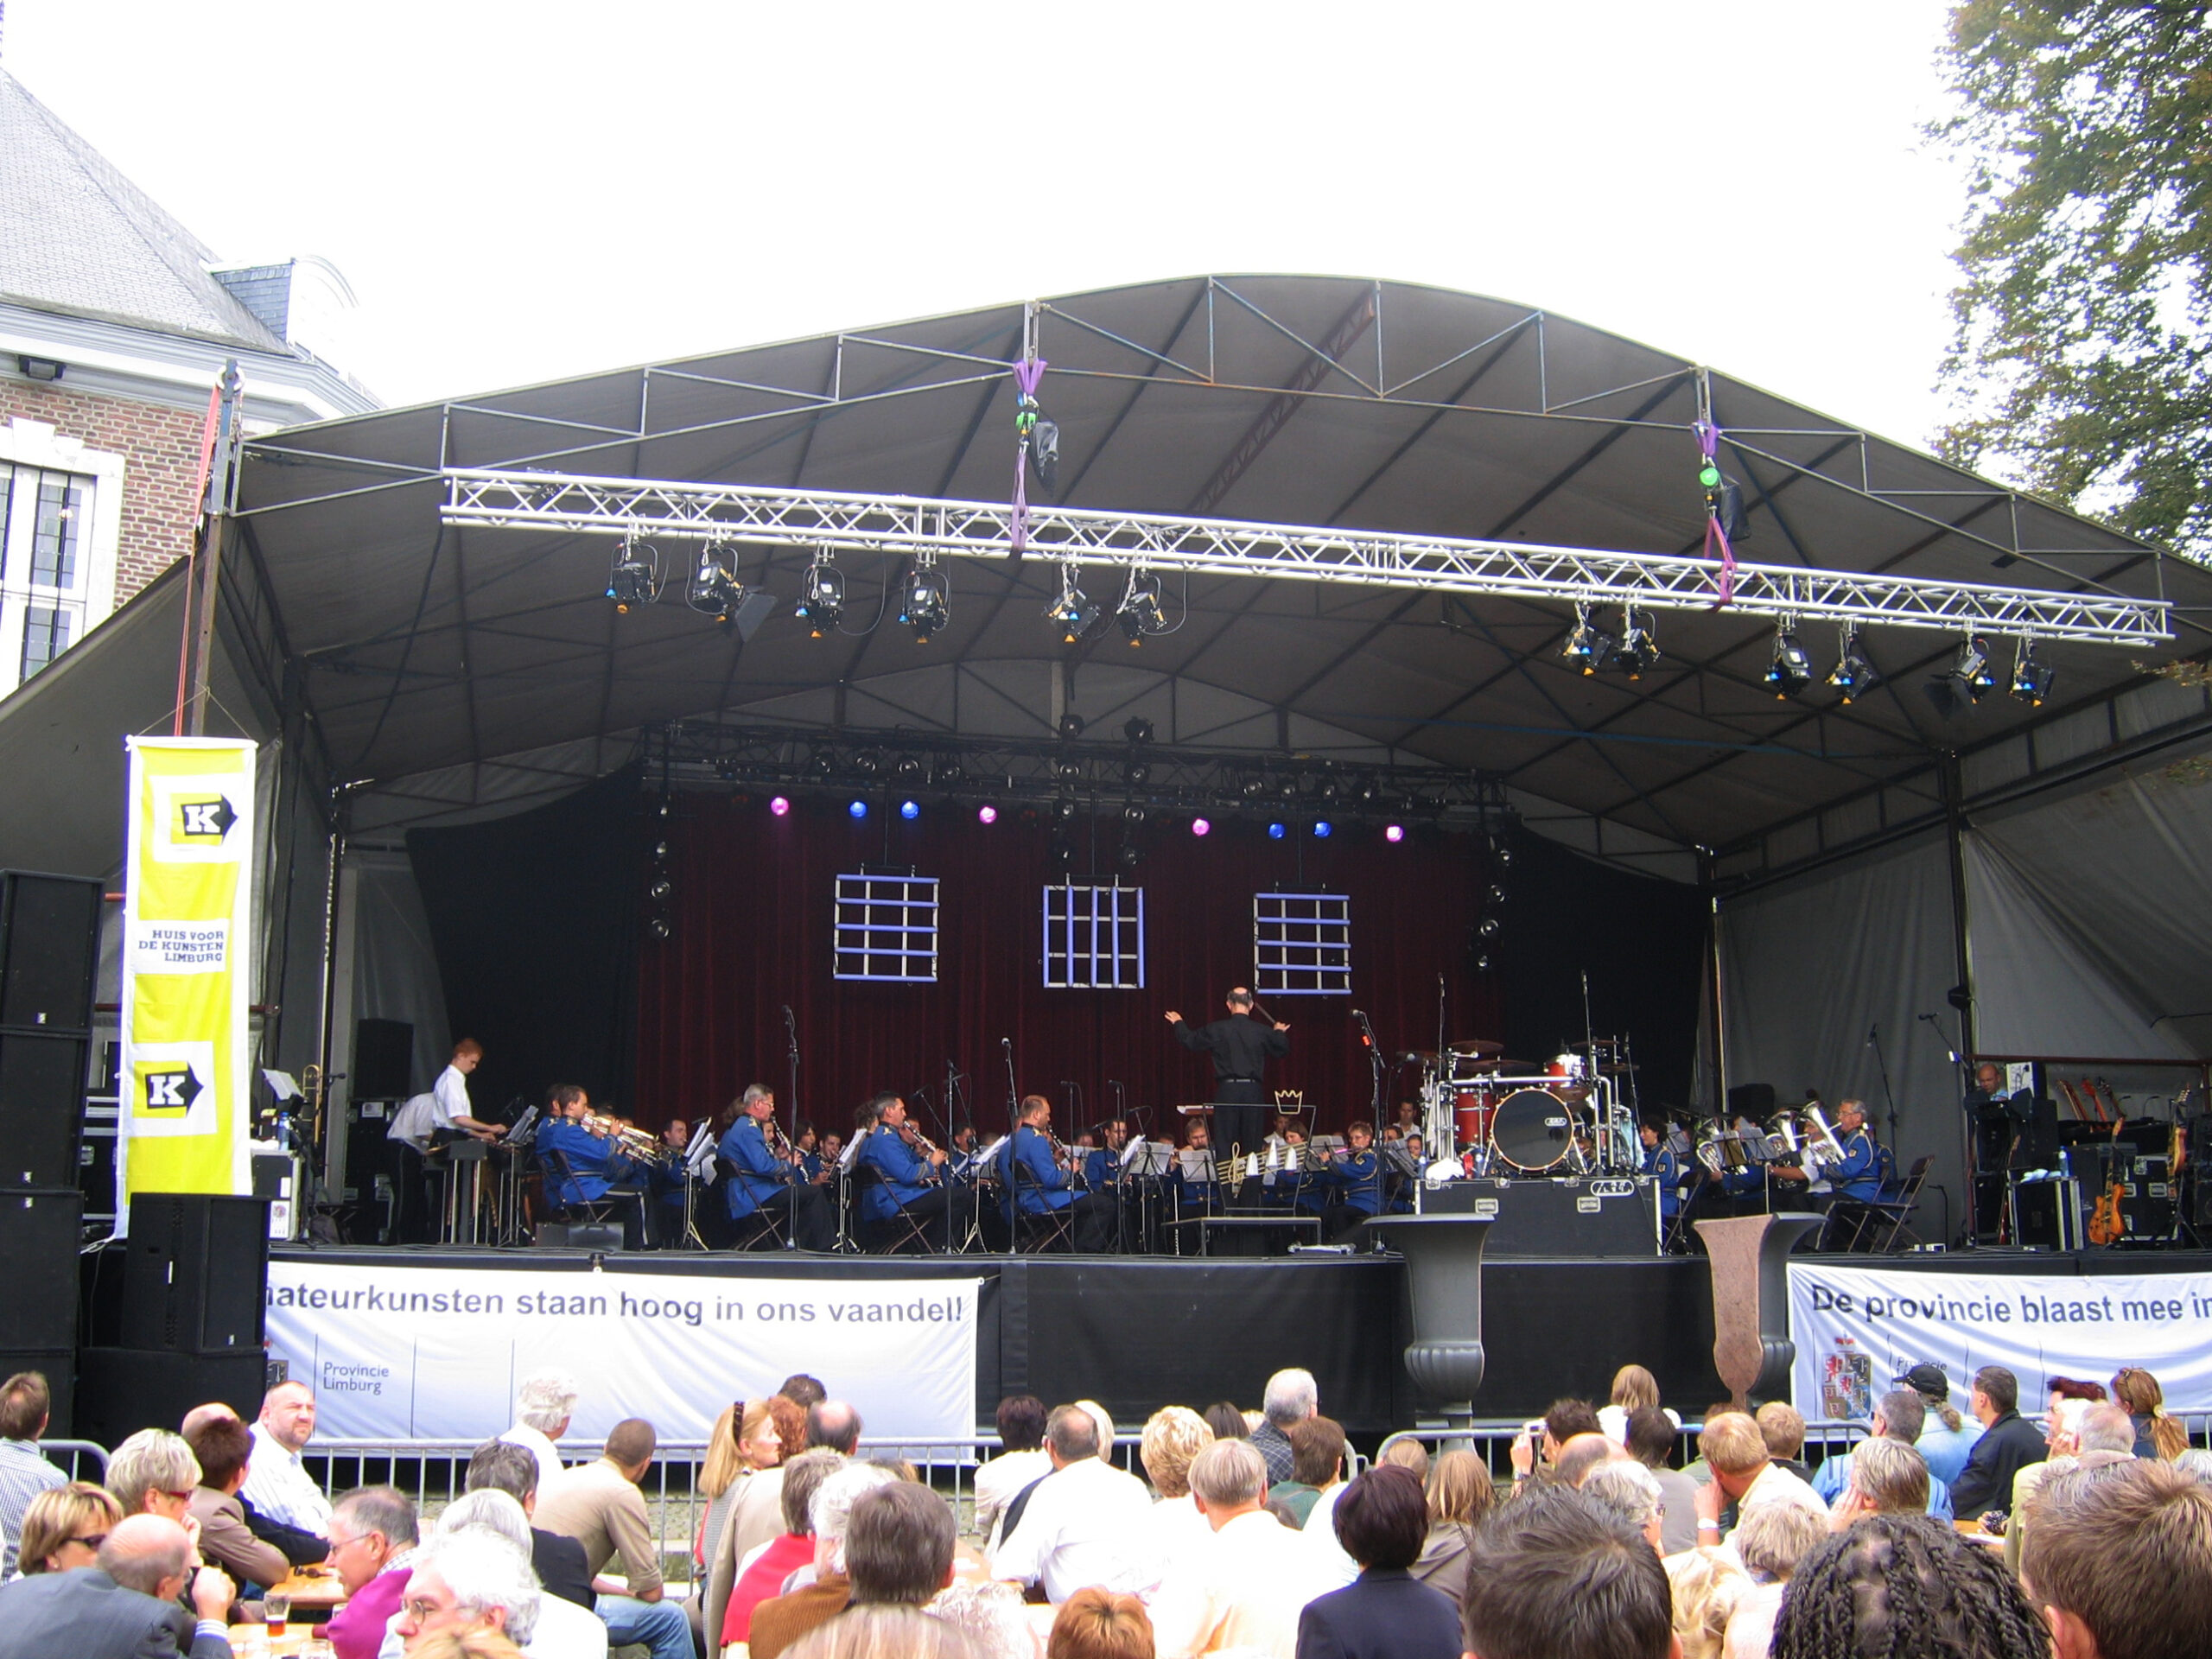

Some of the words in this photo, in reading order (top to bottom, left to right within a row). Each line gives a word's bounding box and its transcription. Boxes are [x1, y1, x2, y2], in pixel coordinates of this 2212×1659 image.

[185, 804, 221, 833] K
[152, 930, 187, 940] HUIS
[189, 931, 224, 941] VOOR
[138, 940, 157, 950] DE
[162, 941, 223, 951] KUNSTEN
[165, 952, 222, 963] LIMBURG
[149, 1075, 186, 1105] K
[516, 1290, 607, 1316] staan
[620, 1291, 702, 1326] hoog
[715, 1296, 744, 1320] in
[756, 1300, 816, 1322] ons
[828, 1296, 963, 1323] vaandel!
[1812, 1285, 1853, 1313] De
[1866, 1294, 2011, 1322] provincie
[2022, 1295, 2114, 1322] blaast
[2122, 1299, 2183, 1321] mee
[322, 1362, 390, 1377] Provincie
[322, 1376, 382, 1395] Limburg
